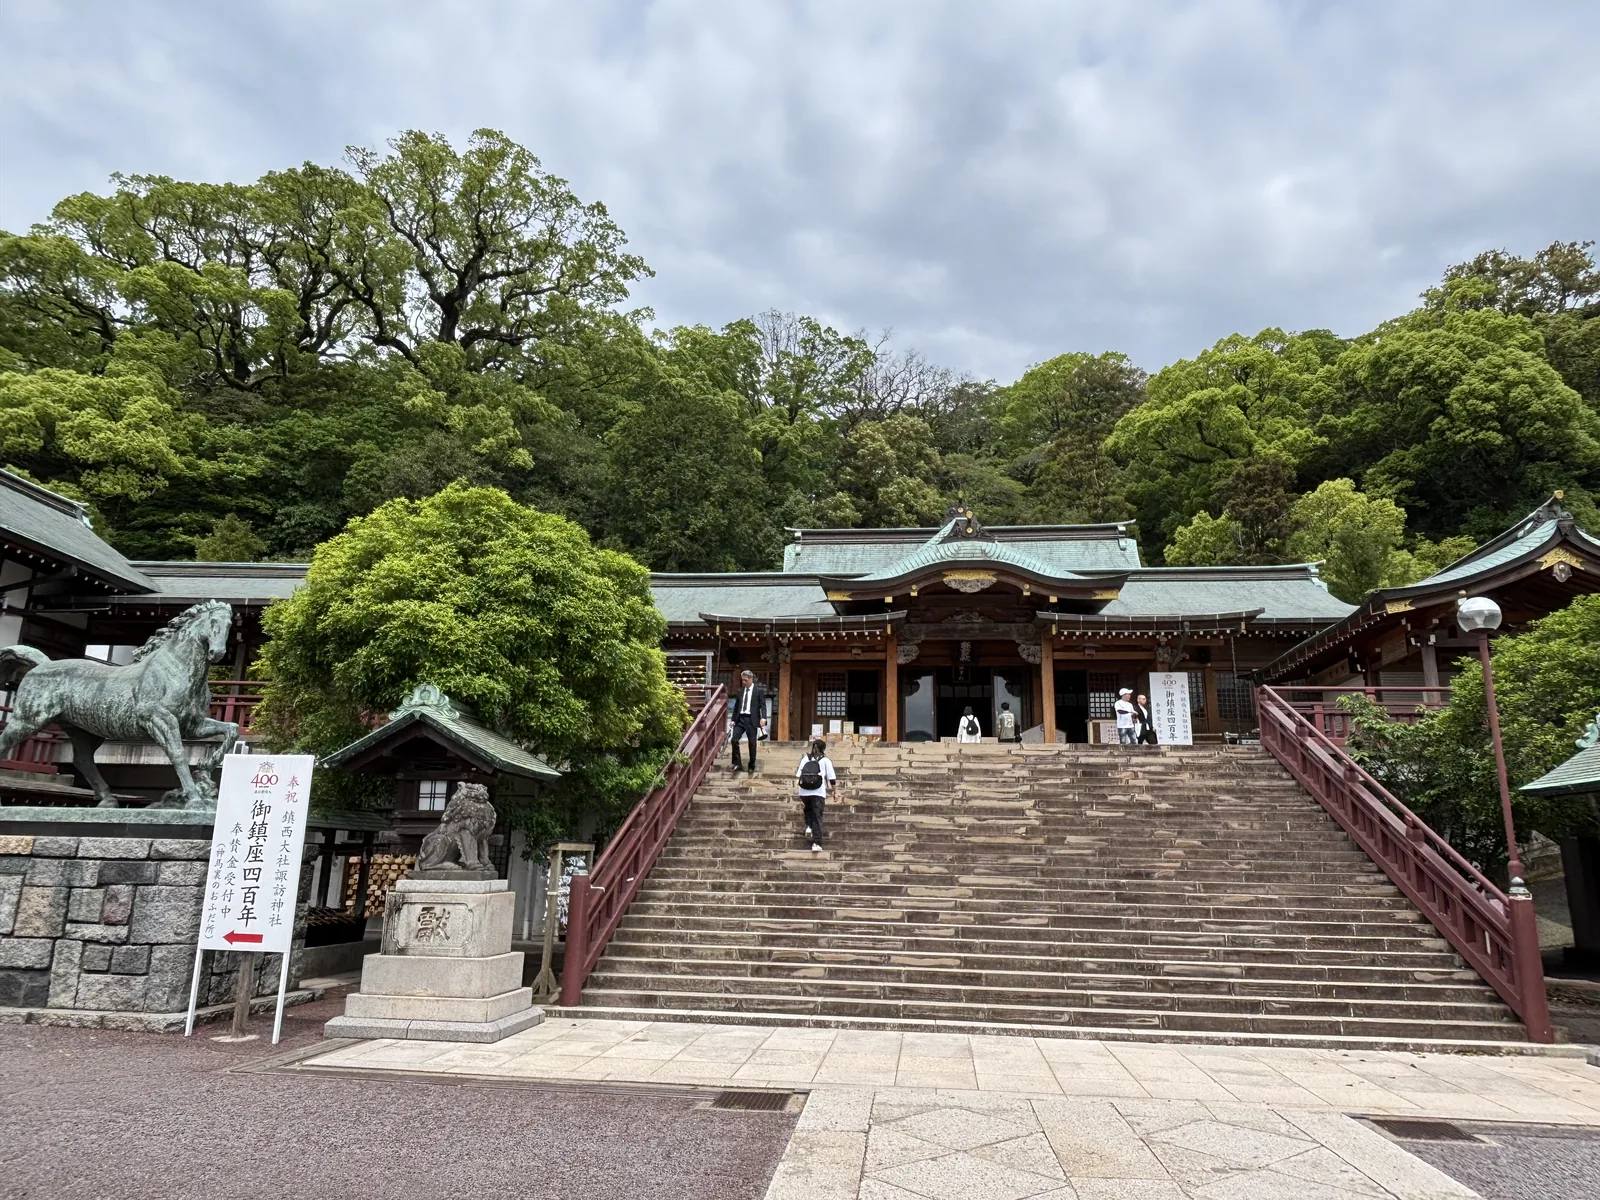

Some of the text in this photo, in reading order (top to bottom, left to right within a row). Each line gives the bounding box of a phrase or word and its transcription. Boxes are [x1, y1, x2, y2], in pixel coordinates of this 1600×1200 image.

[250, 773, 279, 788] 400
[284, 775, 300, 804] 奉祝
[221, 822, 243, 919] 奉賛金受付中
[236, 799, 272, 928] 御鎮座四百年
[268, 810, 296, 927] 鎮西大社諏訪神社
